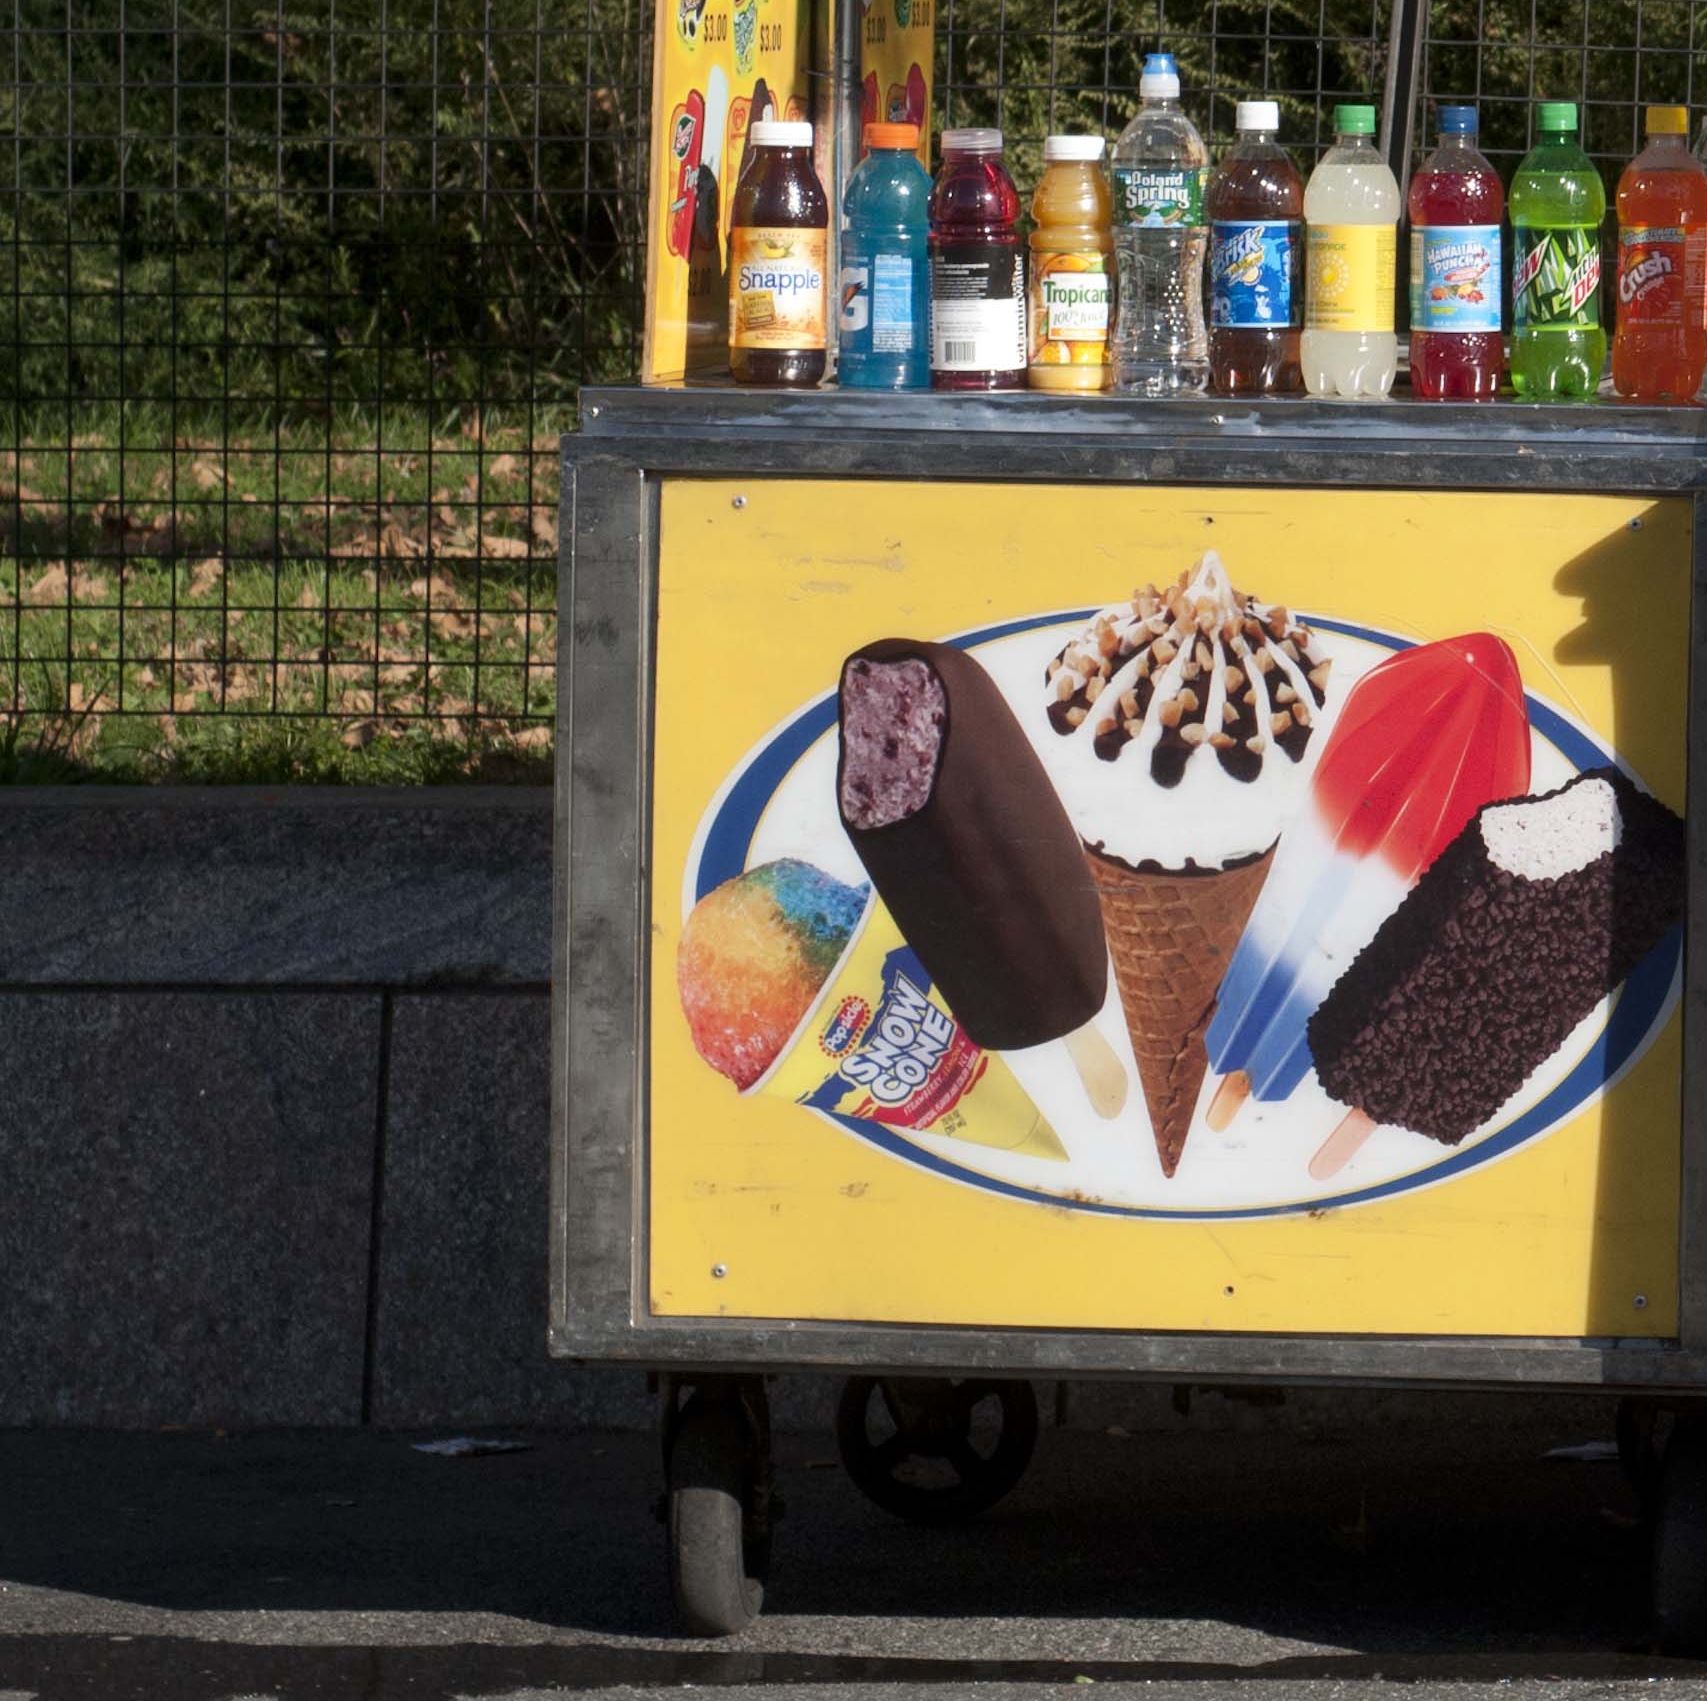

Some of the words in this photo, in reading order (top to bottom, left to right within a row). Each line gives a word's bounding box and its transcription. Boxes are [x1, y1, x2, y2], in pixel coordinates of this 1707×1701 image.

[704, 14, 728, 42] $3.00
[760, 23, 782, 52] $3.00
[1126, 172, 1183, 186] Poland
[1126, 186, 1190, 210] Spring
[739, 266, 820, 295] Snapple
[1620, 251, 1672, 303] Crush
[824, 999, 864, 1049] Popsicle
[839, 970, 929, 1085] SNOW
[871, 1005, 957, 1104] CONE
